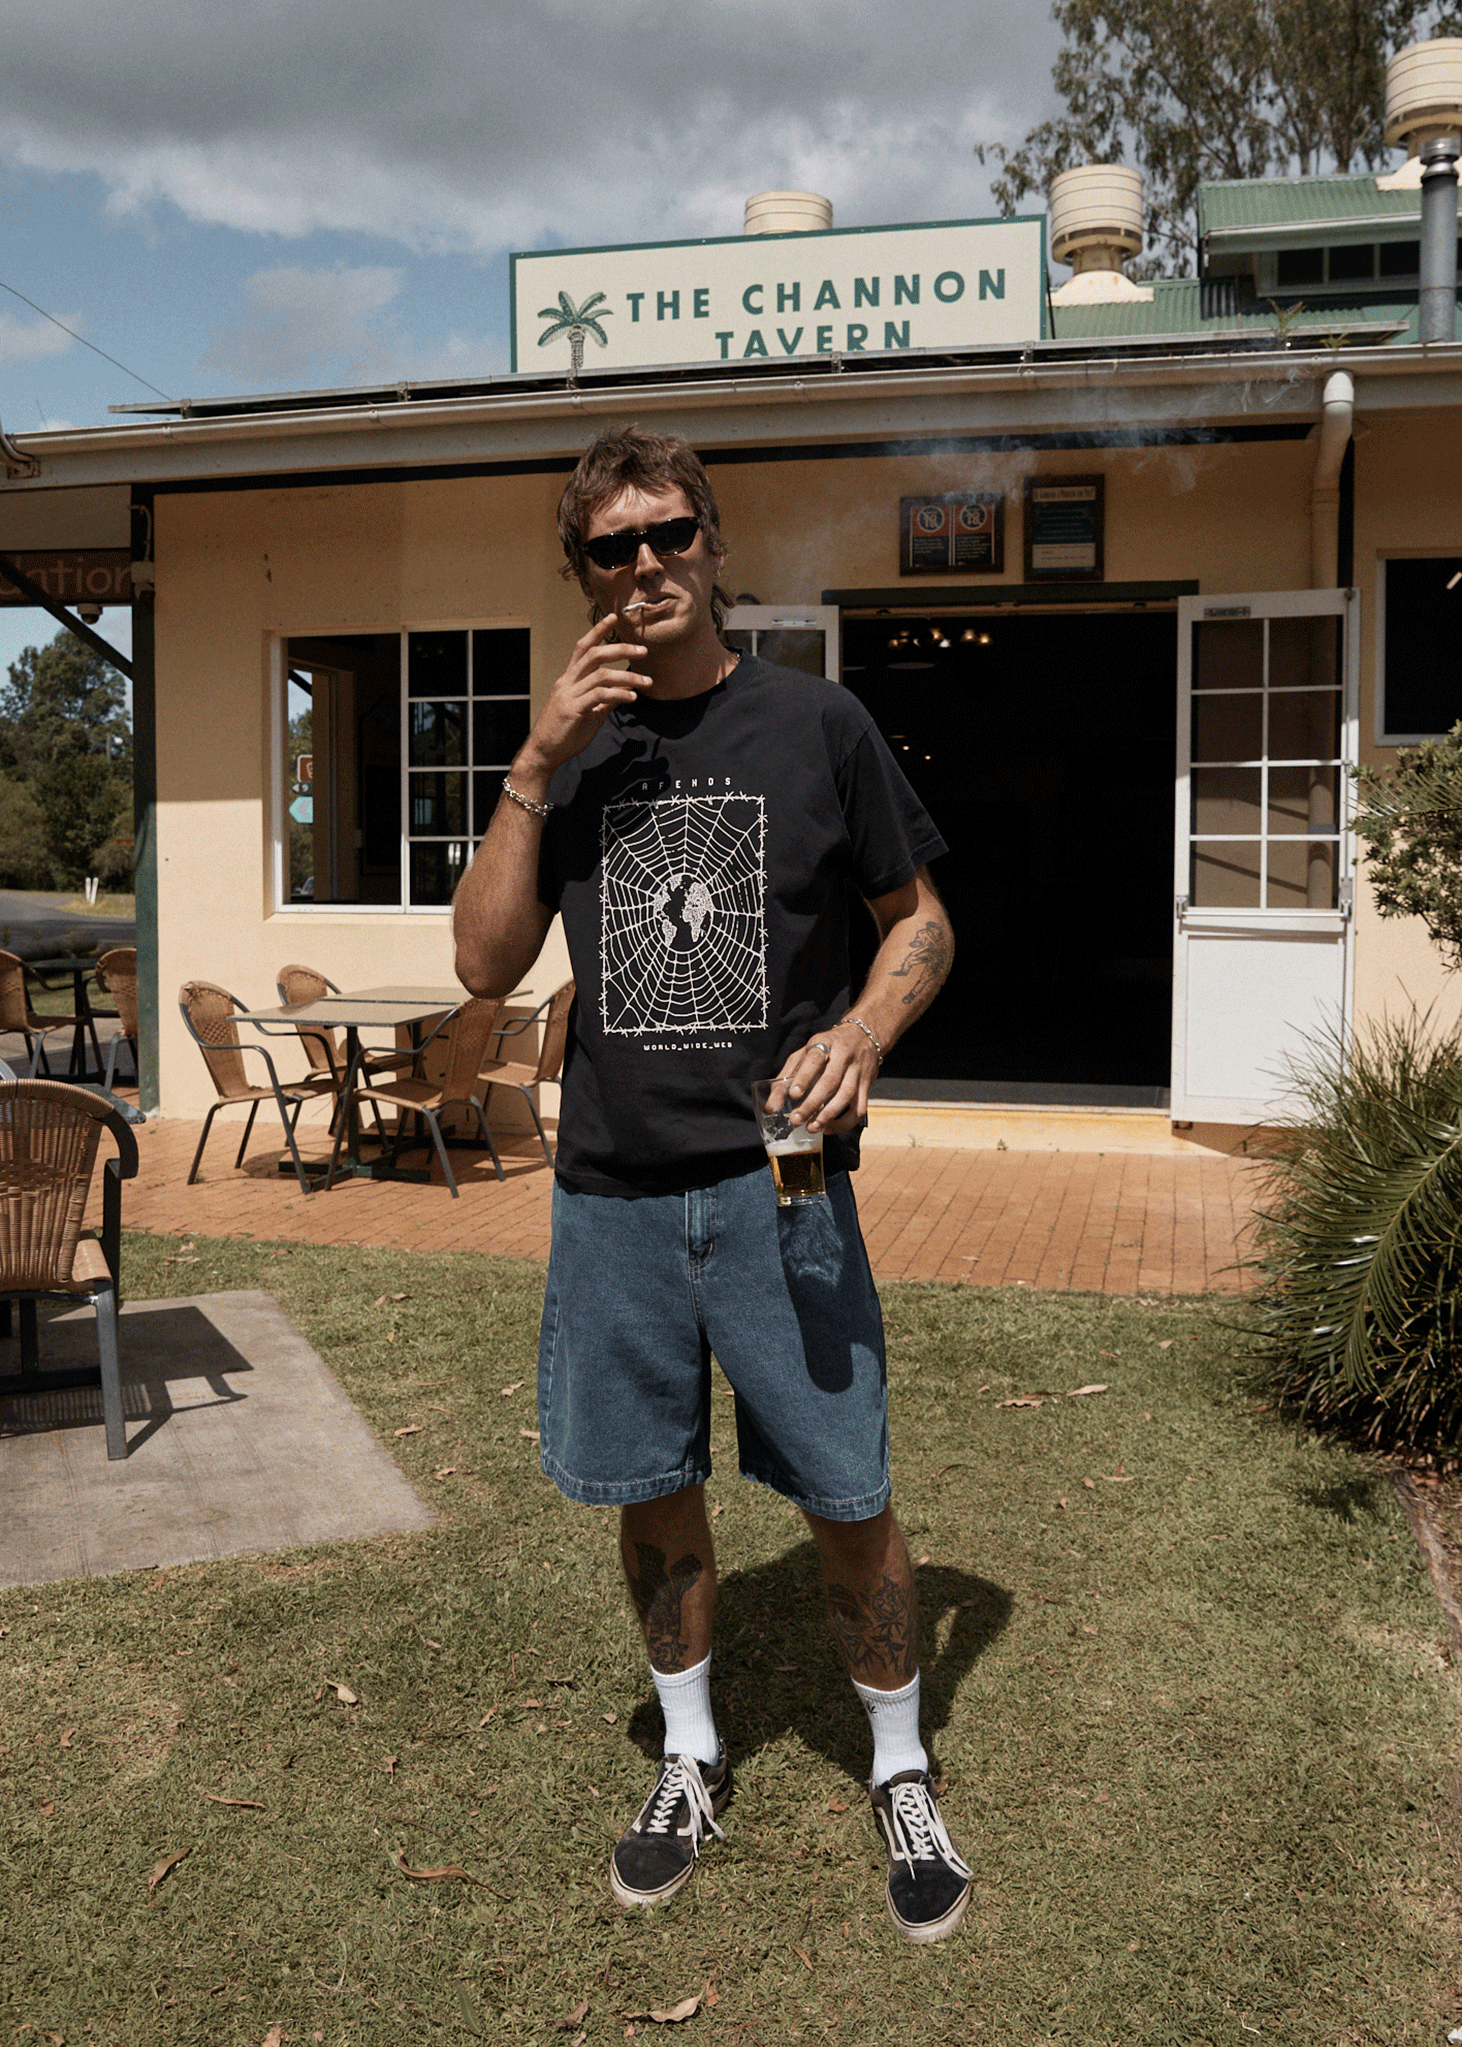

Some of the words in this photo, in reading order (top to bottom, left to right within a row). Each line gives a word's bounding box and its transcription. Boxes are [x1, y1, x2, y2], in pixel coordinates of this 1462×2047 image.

[626, 287, 710, 323] THE
[742, 268, 1006, 316] CHANNON
[715, 320, 911, 360] TAVERN
[642, 777, 731, 791] AFENDS
[643, 1042, 733, 1051] WORLD_WIDE_WEB
